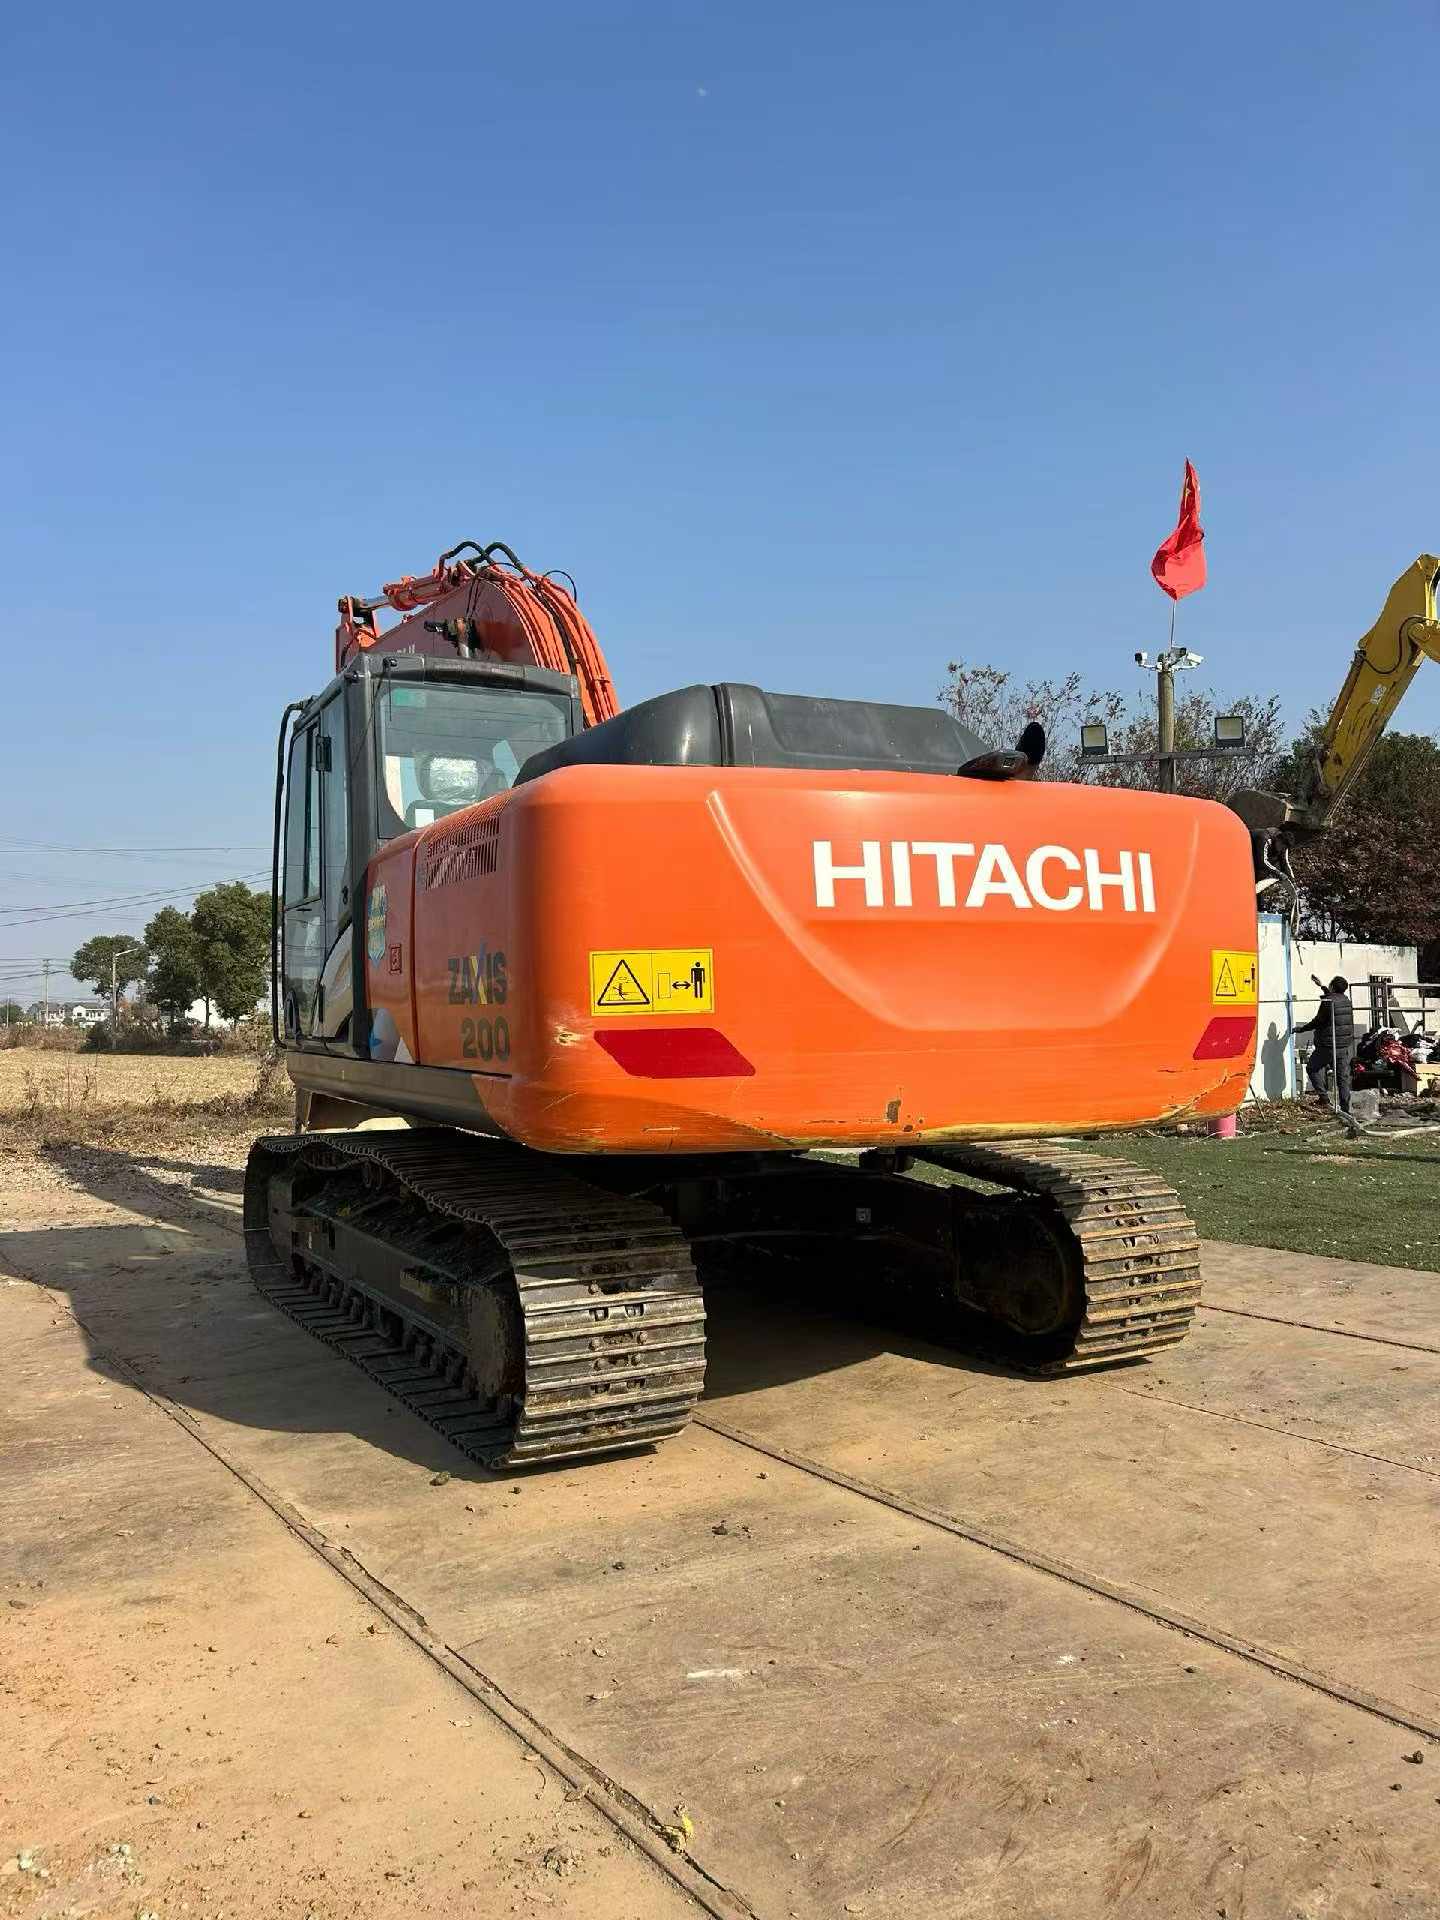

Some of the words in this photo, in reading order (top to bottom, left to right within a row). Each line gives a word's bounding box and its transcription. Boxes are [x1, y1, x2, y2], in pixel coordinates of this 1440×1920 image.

[812, 840, 1157, 913] HITACHI
[447, 939, 508, 1005] ZAXIS
[462, 1015, 511, 1063] 200
